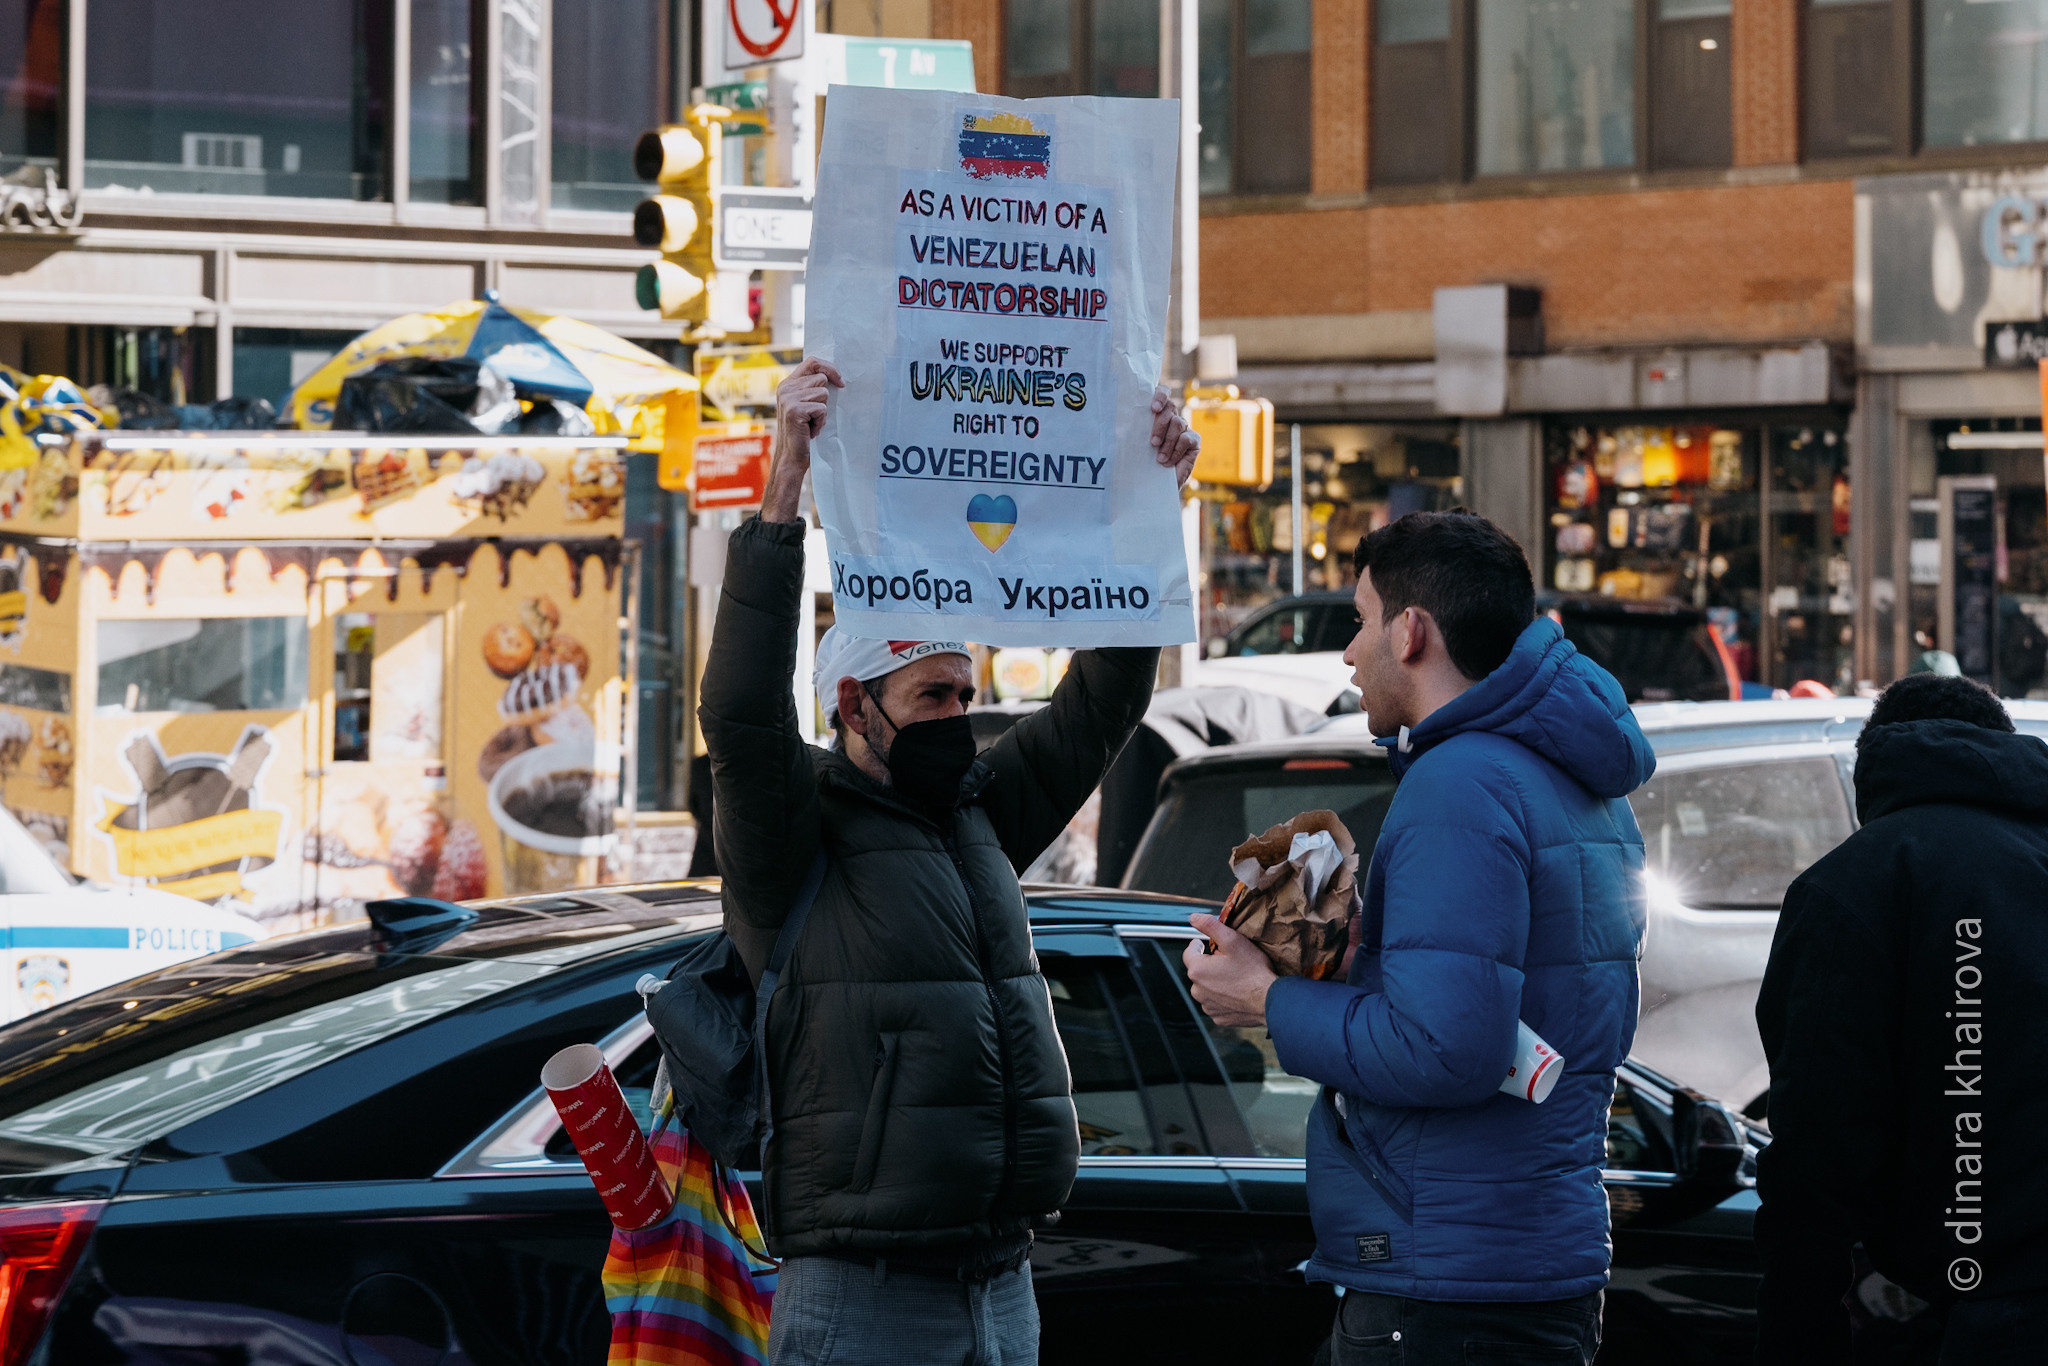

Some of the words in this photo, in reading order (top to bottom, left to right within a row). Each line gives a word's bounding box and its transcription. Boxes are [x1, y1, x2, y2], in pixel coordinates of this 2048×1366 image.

[878, 46, 898, 87] 7
[734, 214, 784, 242] ONE
[900, 188, 935, 217] AS
[938, 194, 955, 221] A
[960, 194, 1048, 226] VICTIM
[1055, 202, 1088, 230] OF
[1090, 207, 1107, 235] A
[910, 234, 1096, 277] VENEZUELAN
[898, 275, 1108, 318] DICTATORSHIP
[940, 337, 970, 363] WE
[974, 342, 1072, 368] SUPPORT
[909, 360, 1088, 412] UKRAINE'S
[953, 413, 1008, 436] RIGHT
[1011, 415, 1040, 439] TO
[880, 443, 1107, 486] SOVEREIGNTY
[834, 559, 973, 608] Хоробра
[997, 576, 1150, 617] Україно
[135, 927, 216, 950] POLICE
